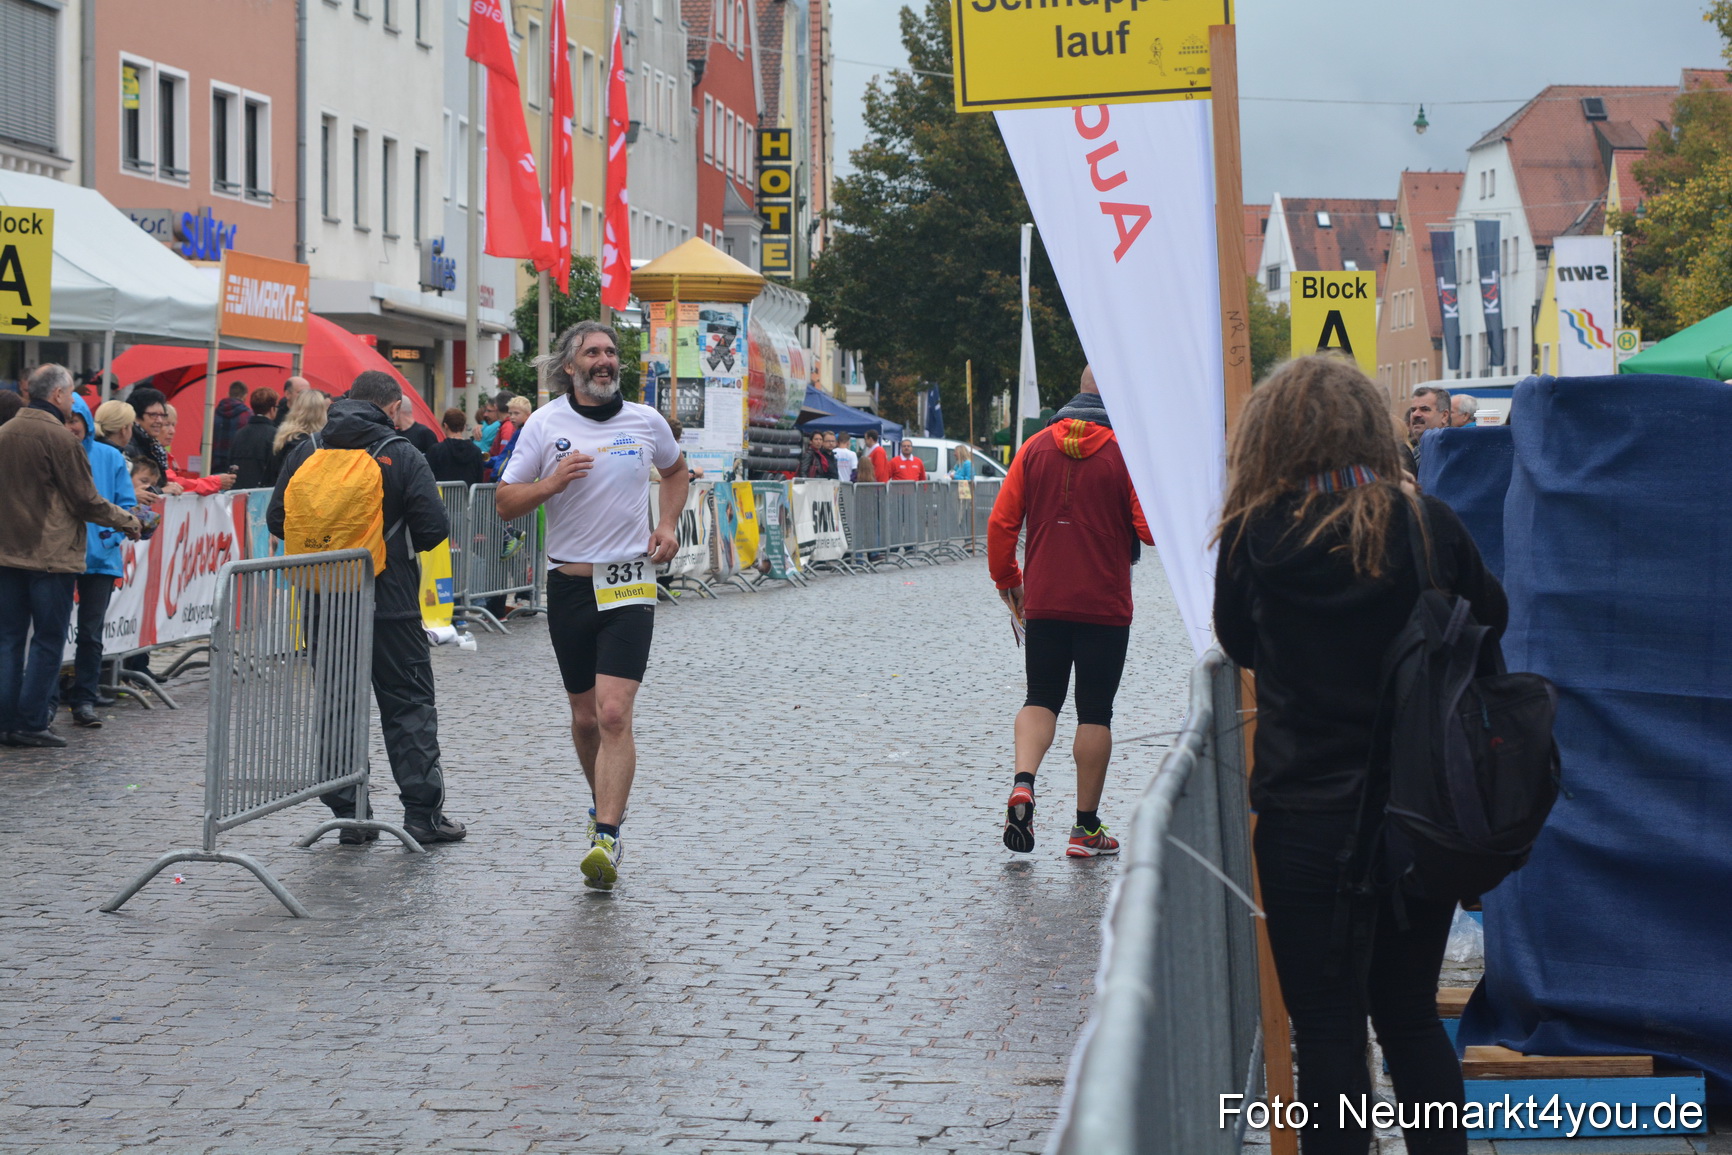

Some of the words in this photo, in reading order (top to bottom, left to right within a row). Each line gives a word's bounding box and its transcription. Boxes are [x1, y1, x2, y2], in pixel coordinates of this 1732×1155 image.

[1055, 20, 1130, 58] lauf
[0, 244, 32, 307] A
[1302, 276, 1368, 299] Block
[1315, 310, 1358, 366] A
[606, 561, 644, 585] 337
[614, 587, 644, 599] Hubert
